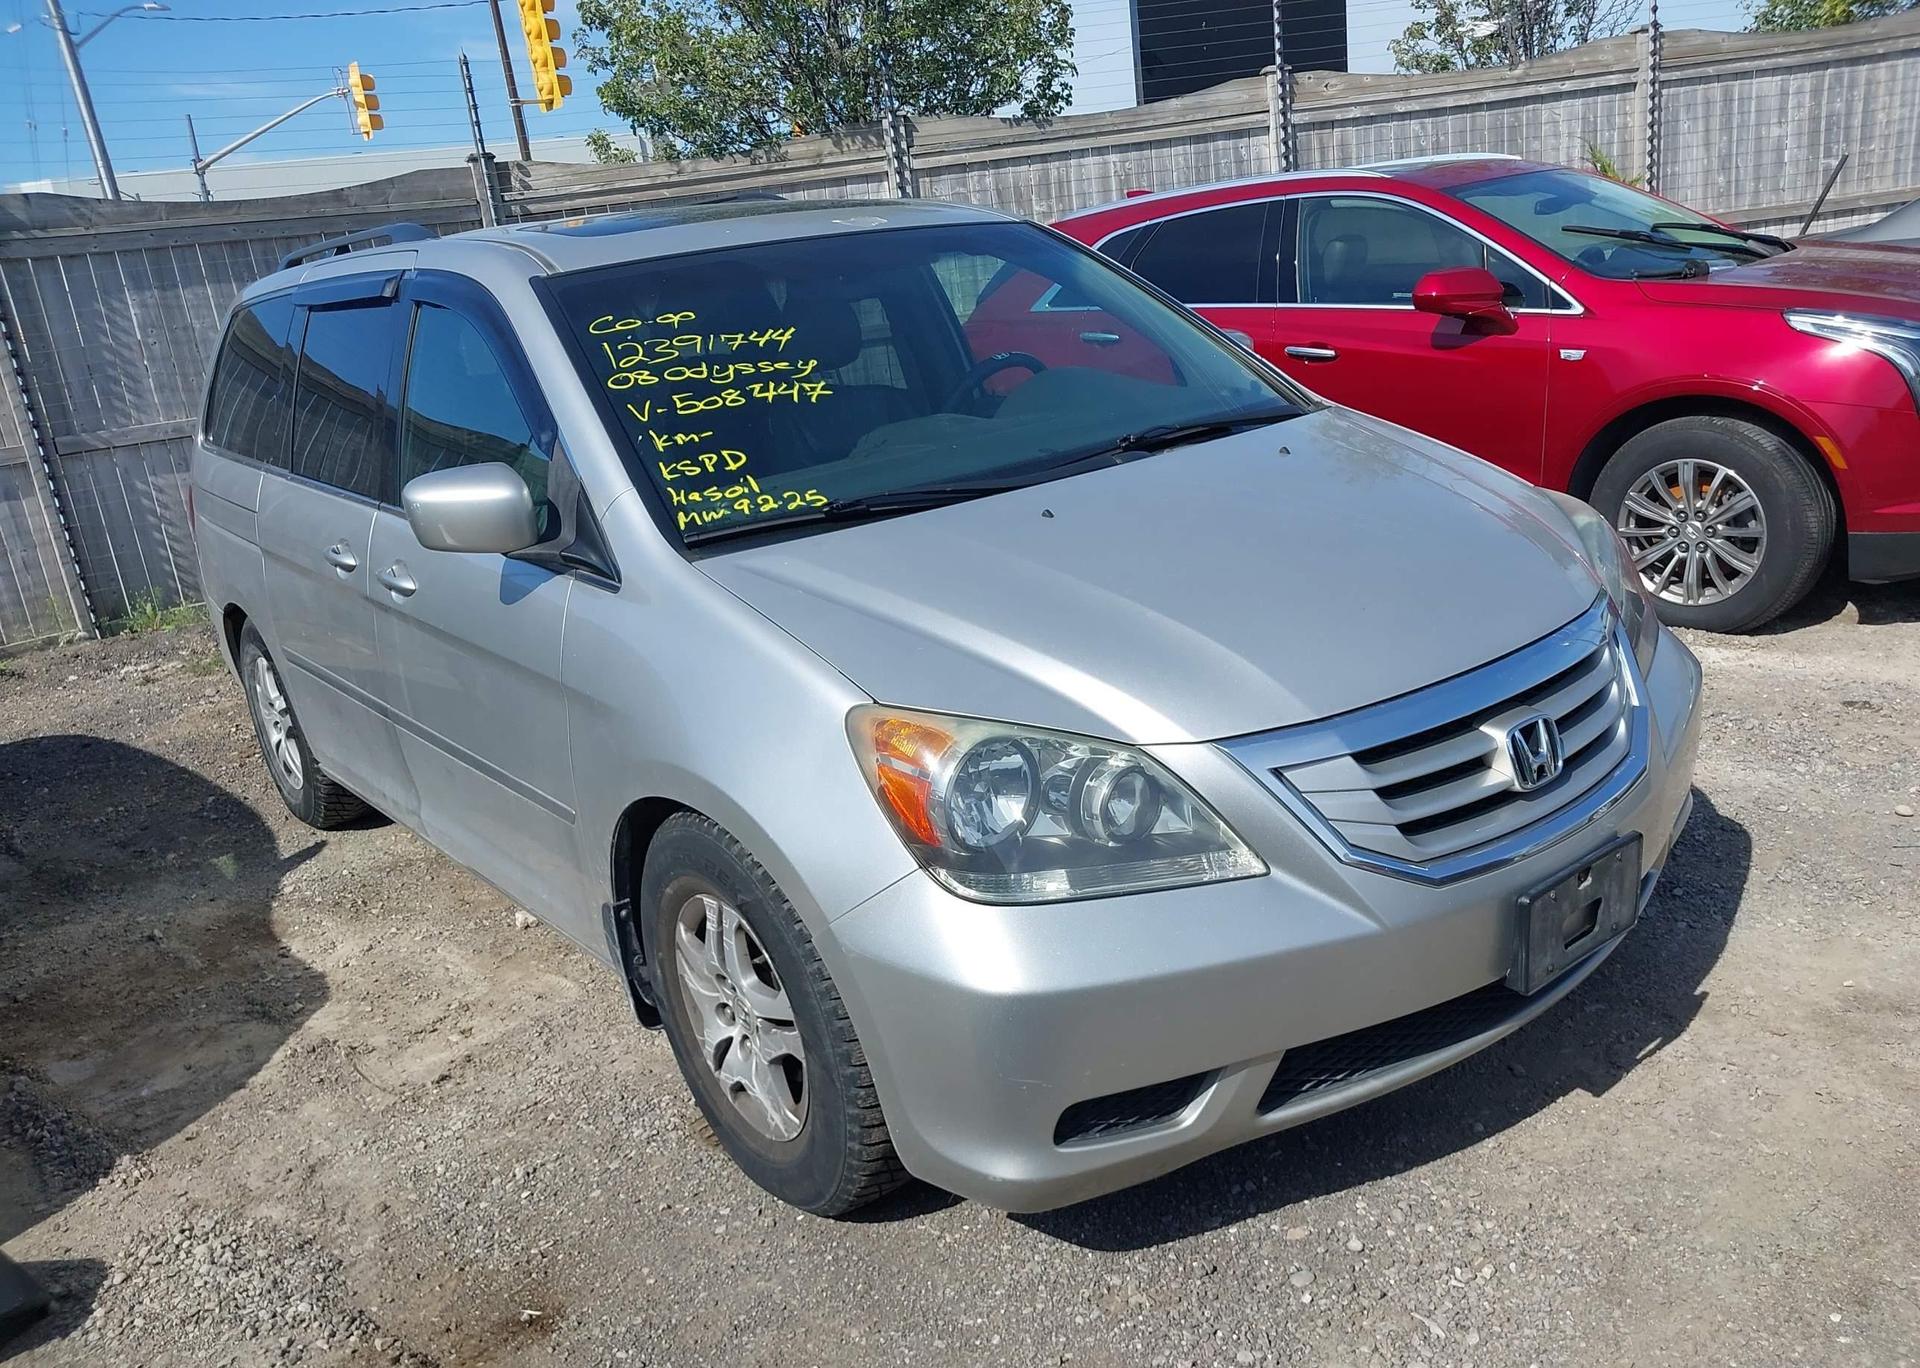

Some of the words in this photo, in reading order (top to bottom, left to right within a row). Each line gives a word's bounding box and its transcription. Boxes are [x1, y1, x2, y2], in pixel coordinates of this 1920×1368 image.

[589, 311, 696, 334] Co-op
[602, 327, 796, 370] 12391744
[608, 370, 659, 389] 08
